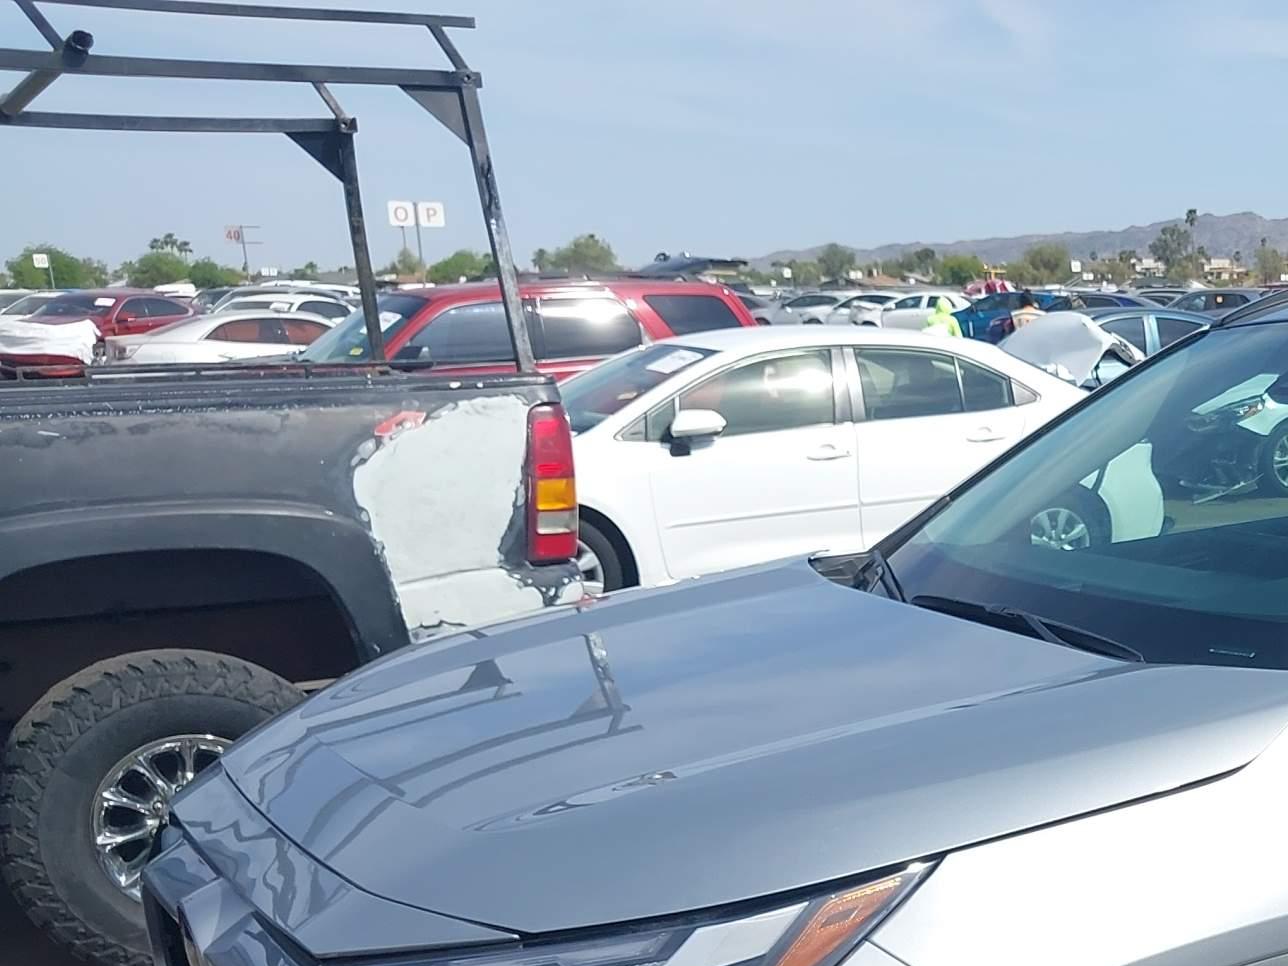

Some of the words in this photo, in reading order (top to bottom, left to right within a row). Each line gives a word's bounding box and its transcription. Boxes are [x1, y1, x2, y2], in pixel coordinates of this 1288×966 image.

[393, 206, 409, 223] O
[426, 207, 438, 223] P
[226, 230, 240, 241] 40
